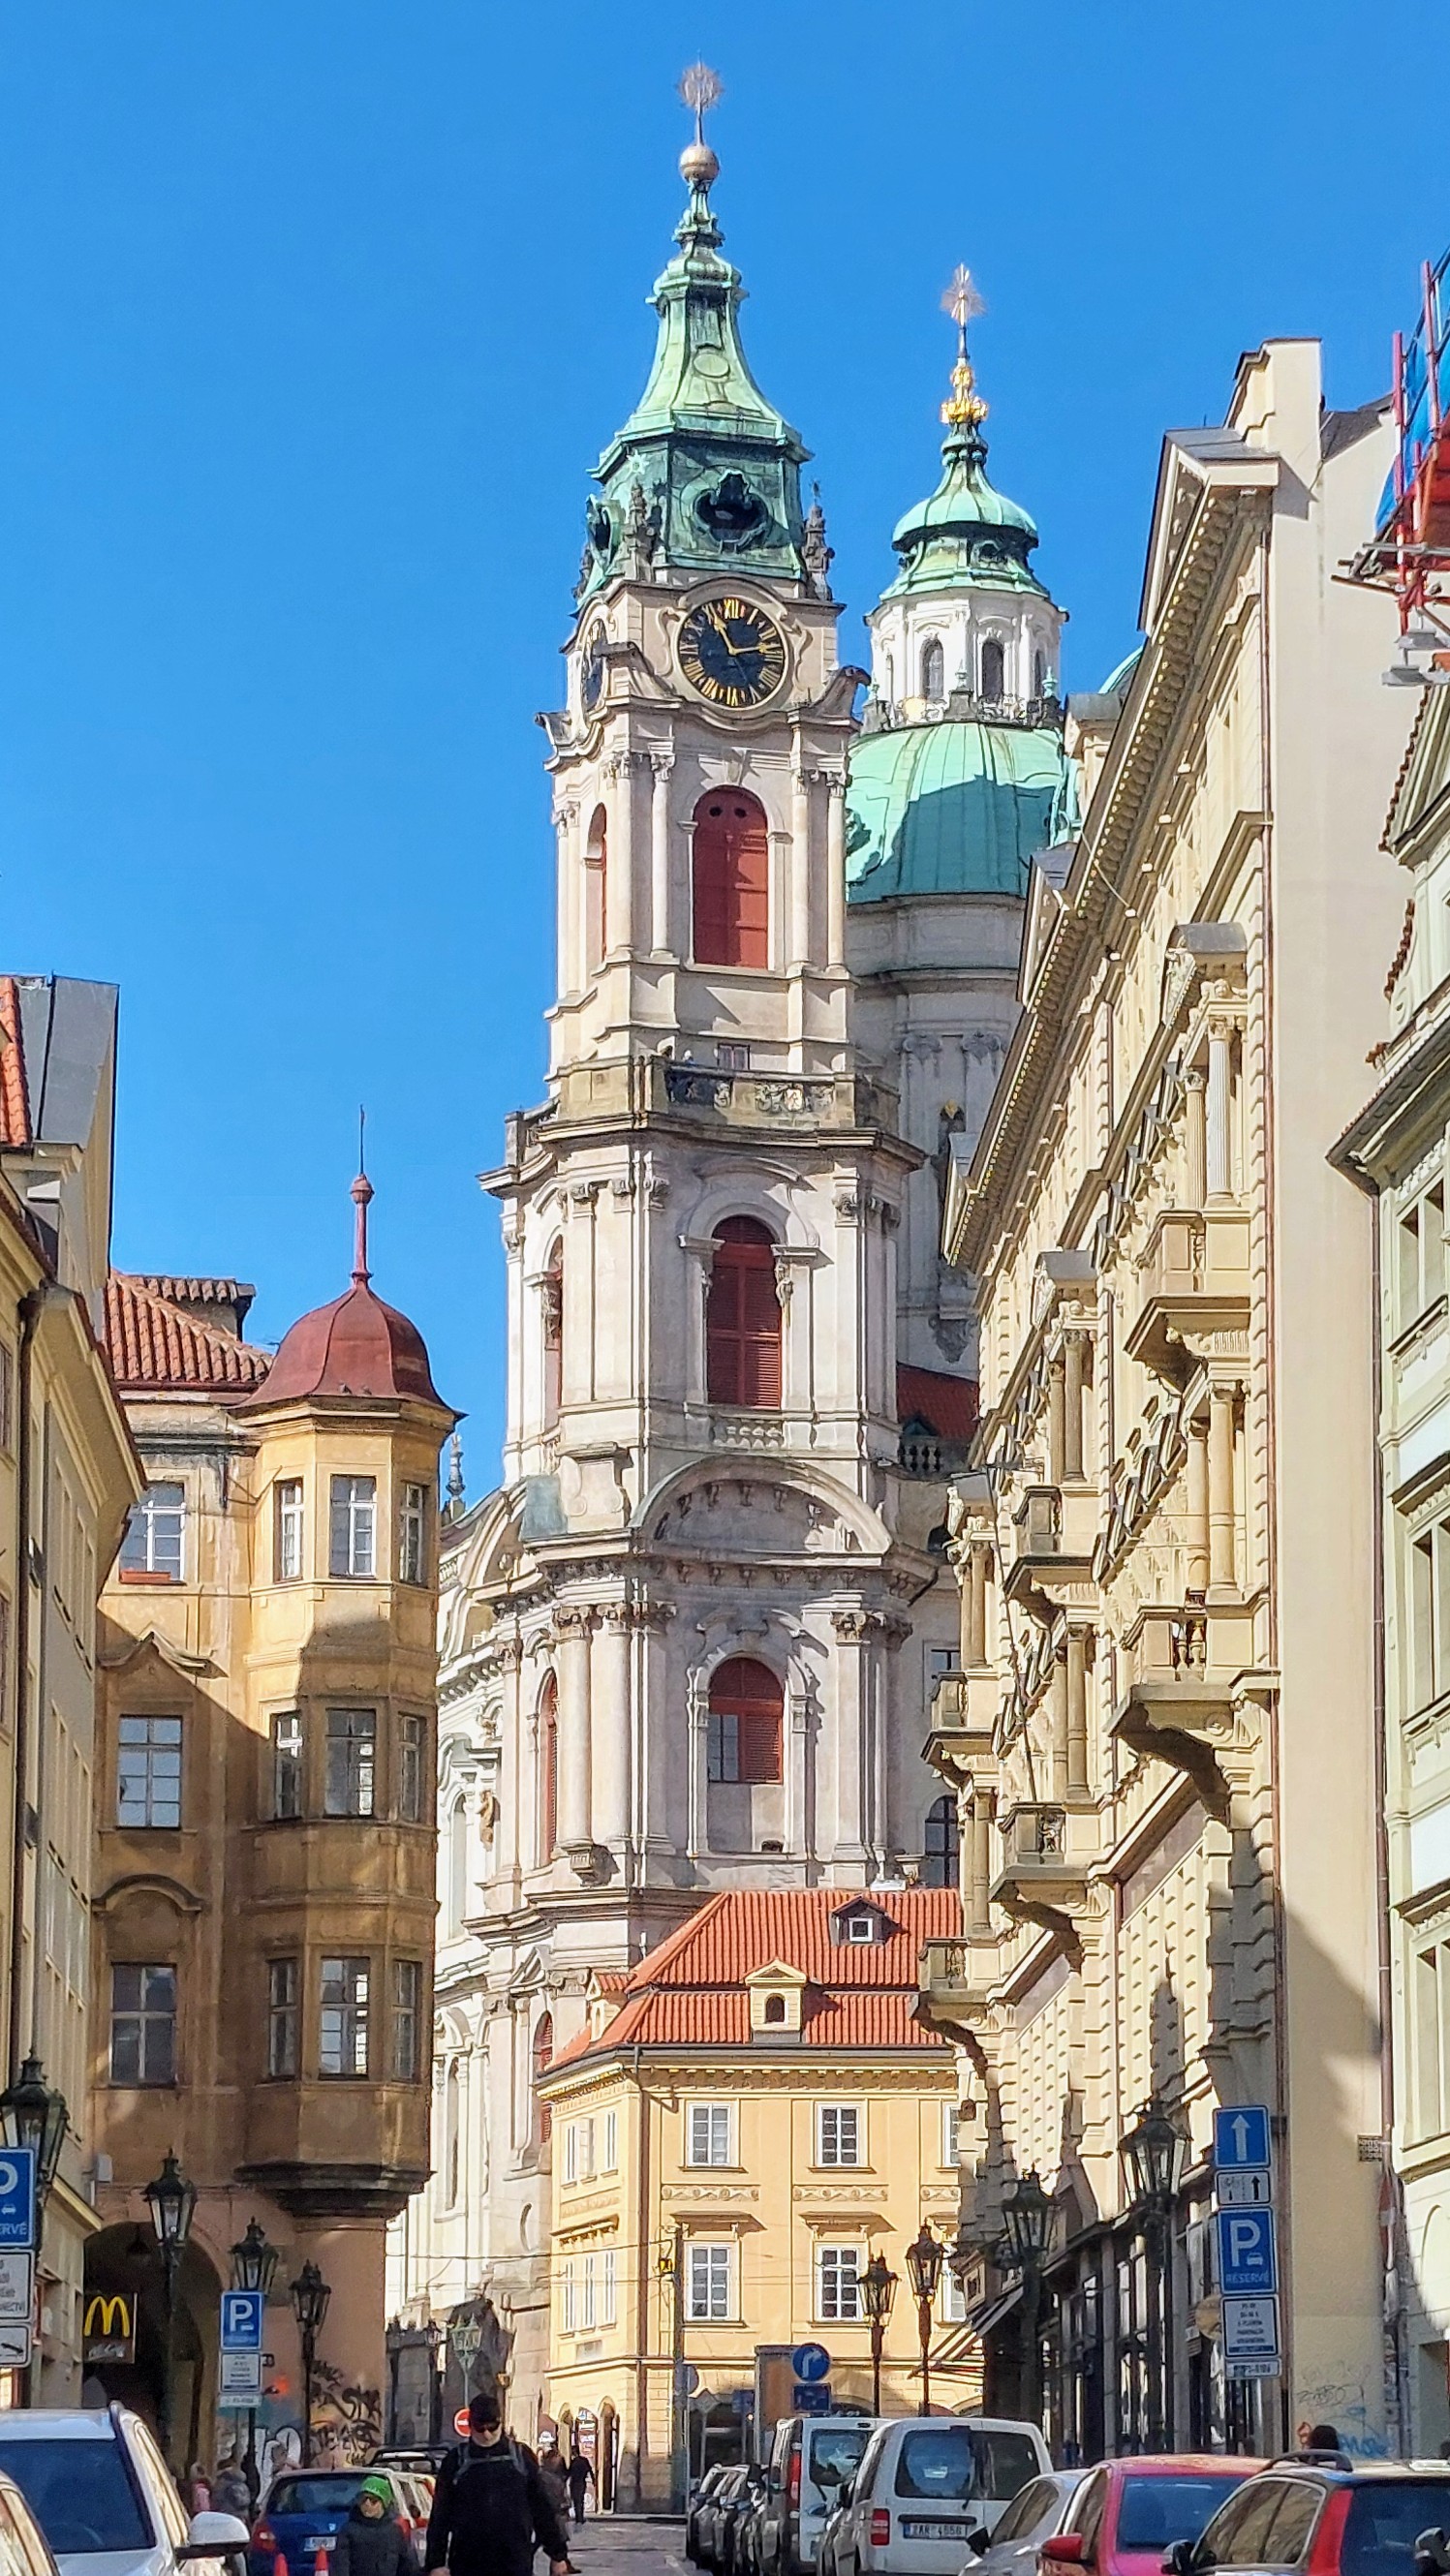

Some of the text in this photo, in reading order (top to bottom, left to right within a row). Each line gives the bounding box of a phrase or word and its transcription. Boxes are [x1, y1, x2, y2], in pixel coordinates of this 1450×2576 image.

[724, 598, 739, 620] XII
[746, 608, 758, 626] I
[758, 627, 777, 641] II
[726, 686, 738, 706] VI
[1230, 2219, 1261, 2267] P
[230, 2299, 254, 2332] P
